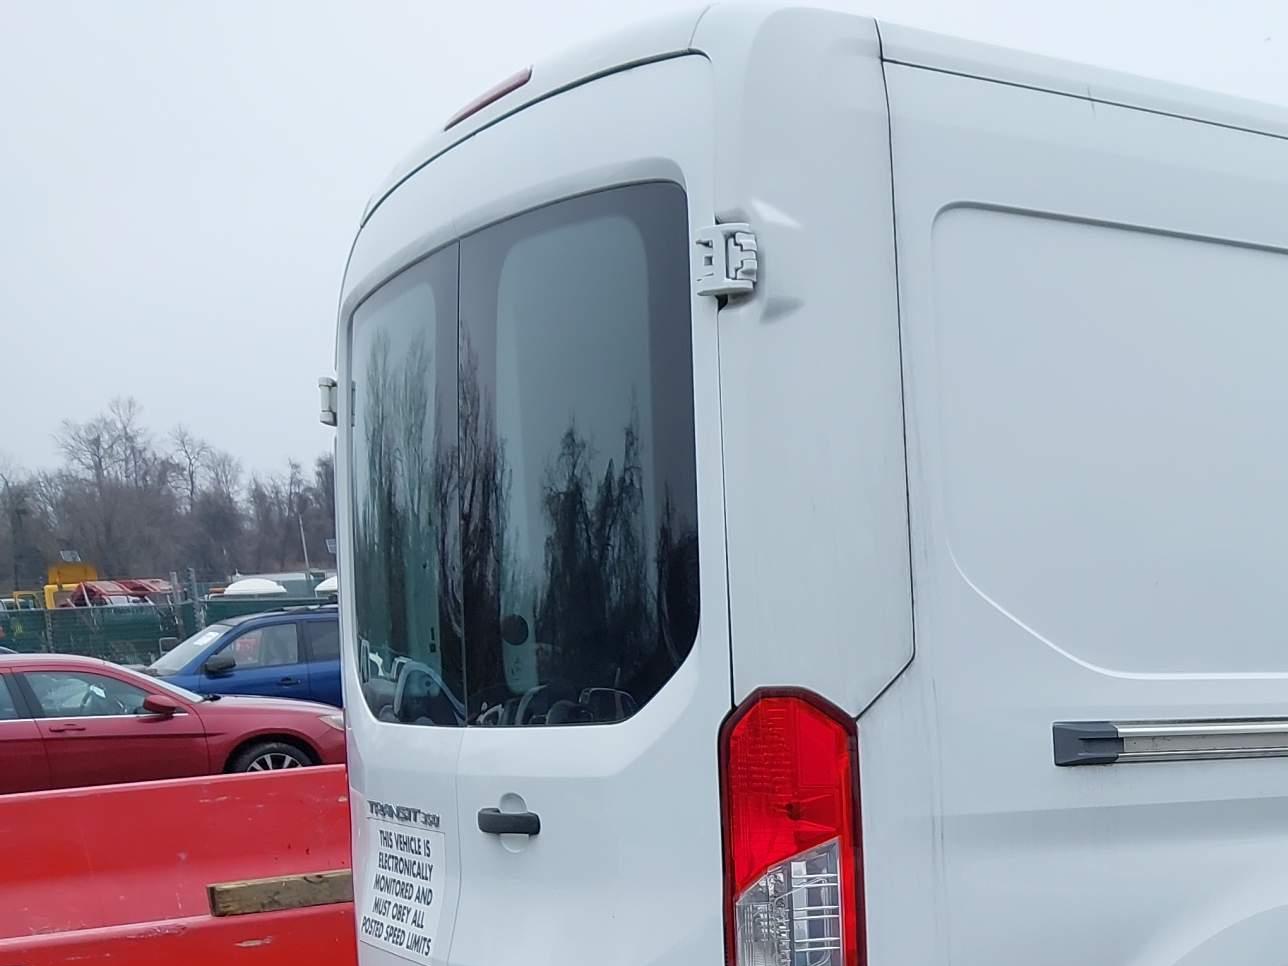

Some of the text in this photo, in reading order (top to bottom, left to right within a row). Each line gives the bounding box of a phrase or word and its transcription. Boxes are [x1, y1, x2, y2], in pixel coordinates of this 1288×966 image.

[379, 829, 431, 858] THIS VEHICLE IS
[378, 851, 433, 882] ELECTRONICALLY
[373, 874, 433, 906] MONITORED AND
[372, 896, 425, 929] MUST OBEY ALL
[361, 915, 432, 956] POSTED SPEED LIMITS
